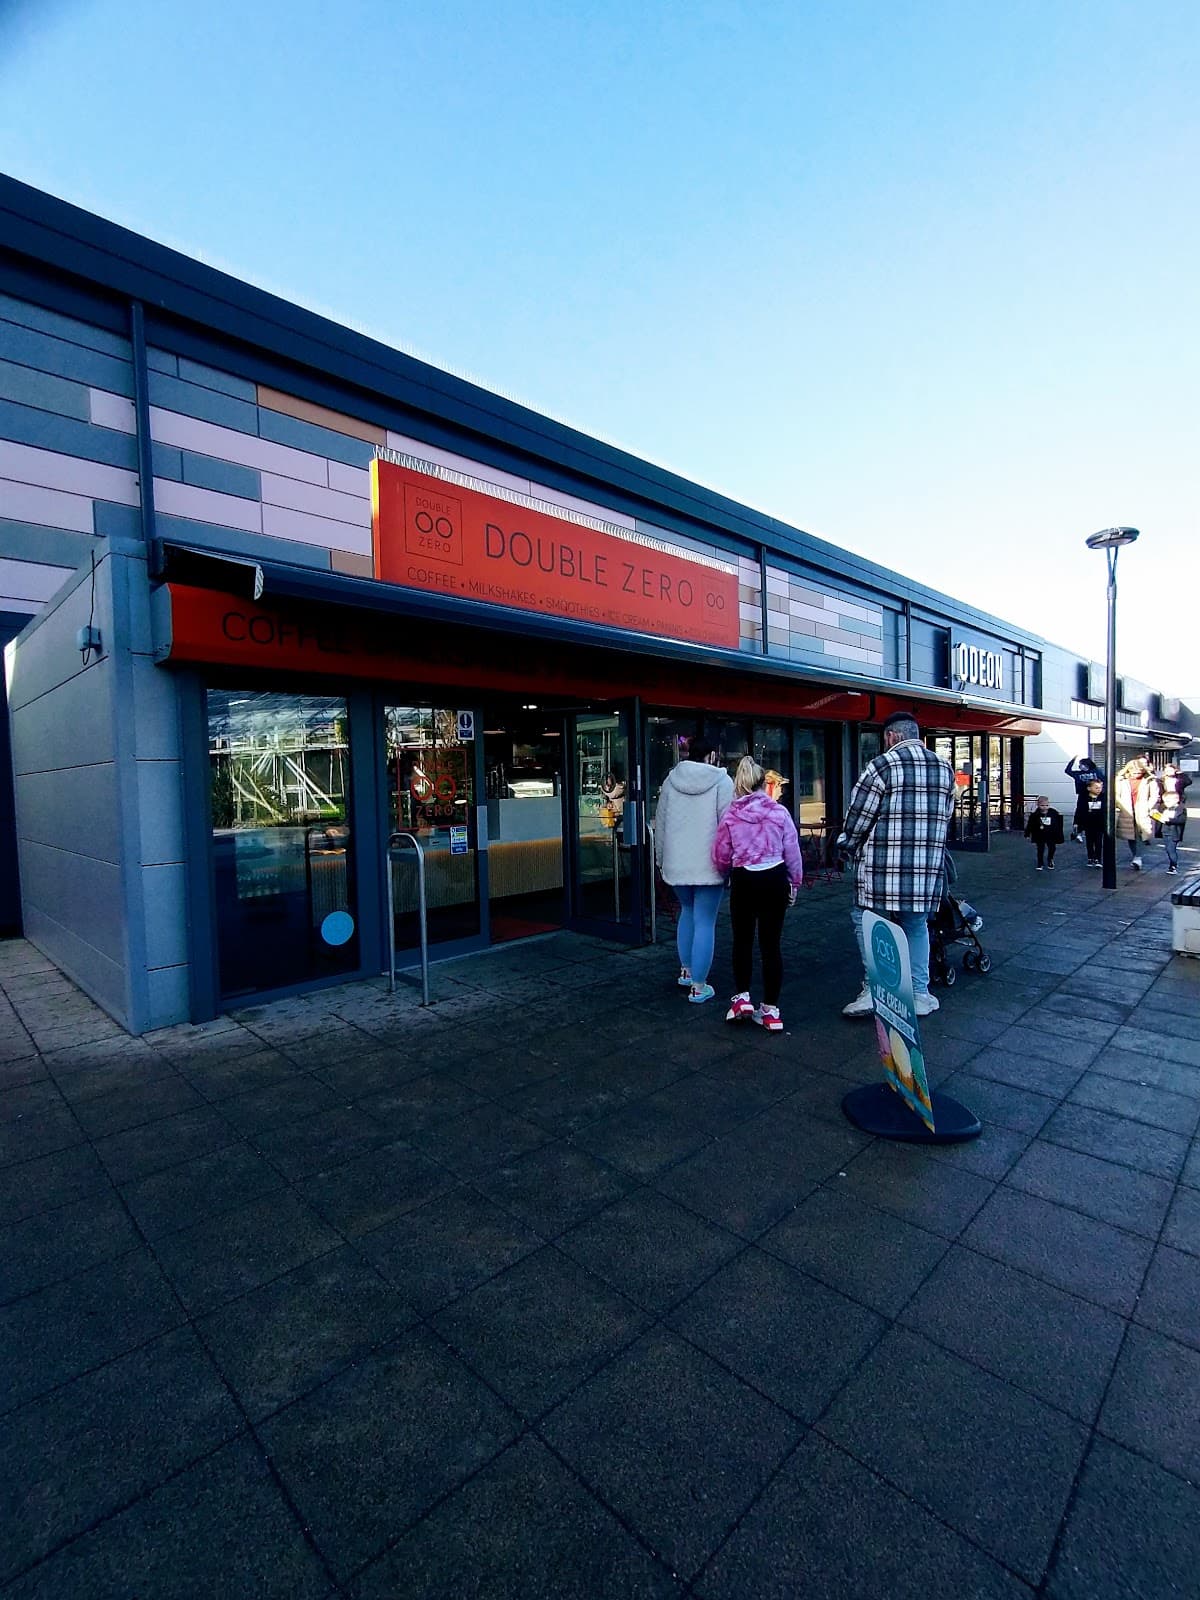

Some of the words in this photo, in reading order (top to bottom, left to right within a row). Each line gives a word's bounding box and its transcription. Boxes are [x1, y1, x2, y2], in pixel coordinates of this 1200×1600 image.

[416, 496, 451, 514] DOUBLE
[418, 536, 451, 553] ZERO
[484, 523, 608, 587] DOUBLE
[621, 562, 694, 607] ZERO
[407, 566, 457, 589] COFFEE
[468, 580, 537, 606] MILKSHAKES
[545, 596, 600, 618] SMOOTHIES
[622, 613, 650, 627] CREAM
[959, 642, 1003, 690] ODEON
[415, 804, 454, 818] ZERO
[876, 983, 886, 1003] ICE
[886, 991, 908, 1020] CREAM
